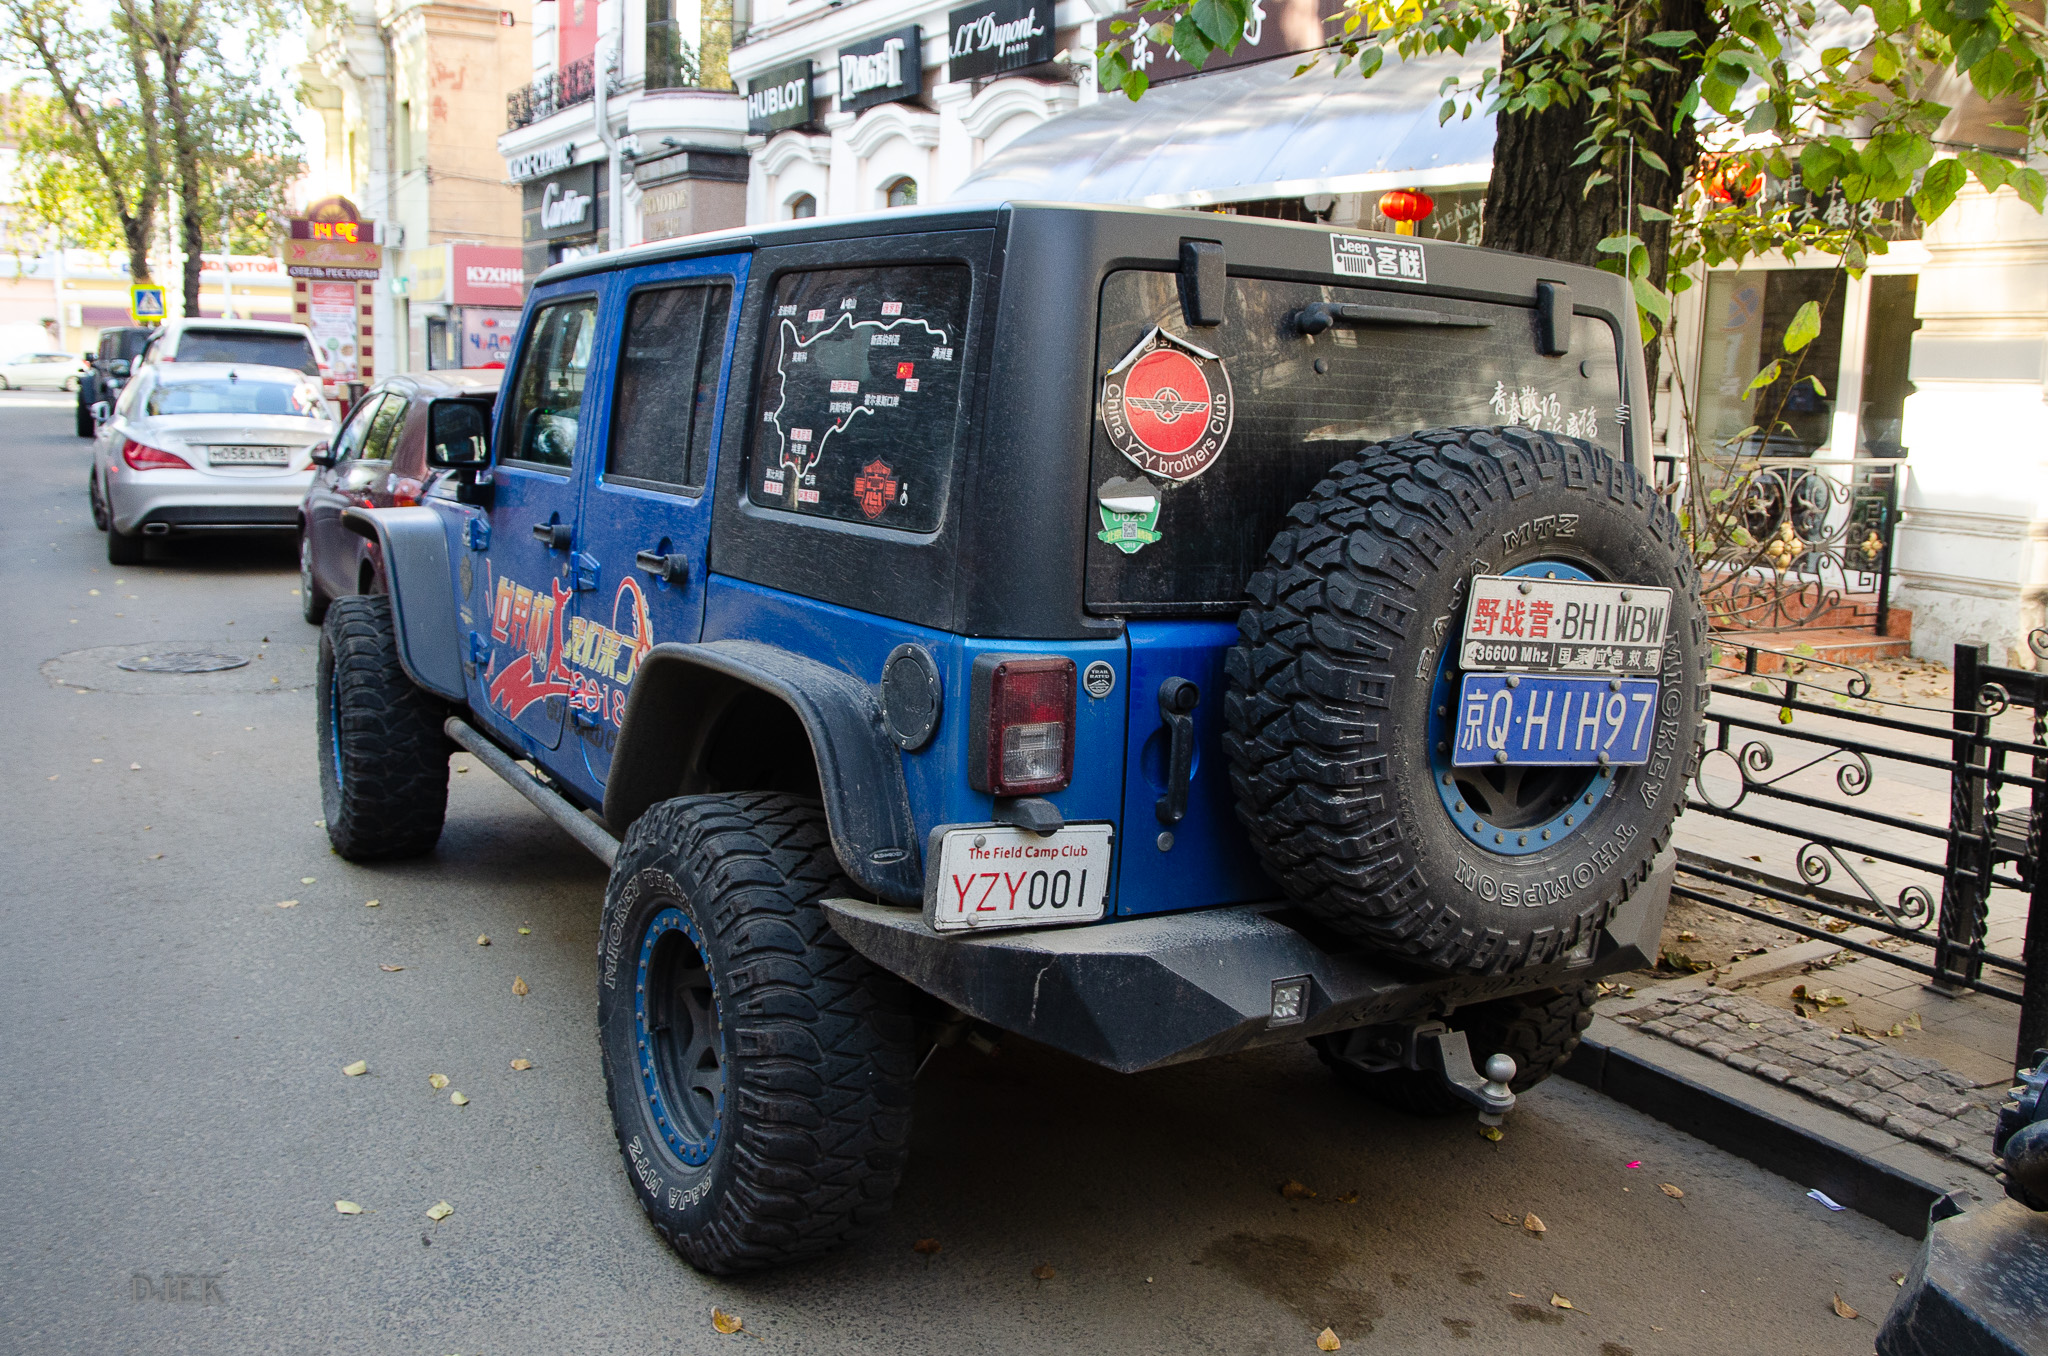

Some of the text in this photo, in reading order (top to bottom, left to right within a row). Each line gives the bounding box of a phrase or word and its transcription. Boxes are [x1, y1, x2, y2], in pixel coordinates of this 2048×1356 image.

[978, 7, 1044, 57] Dupont
[1006, 42, 1029, 54] PARIS
[840, 38, 905, 101] PIAGET
[748, 79, 806, 120] HUBLOT
[541, 182, 592, 230] Cartier
[313, 222, 333, 240] 14
[1339, 239, 1371, 256] Jeep
[289, 267, 379, 279] ОТЕЛЬ РЕСТОРАН
[466, 266, 524, 282] КУХНИ
[1375, 246, 1421, 277] 客栈
[905, 380, 918, 391] 中国
[1107, 383, 1226, 473] China YZY brothers Club
[1503, 513, 1579, 555] MTZ
[564, 615, 643, 686] 我们来了
[1469, 643, 1548, 663] 436600 Mhz
[1558, 647, 1661, 670] 国家应急救援
[1639, 631, 1683, 810] MICKEY
[969, 845, 1088, 861] The Field Camp Club
[1454, 824, 1639, 908] THOMPSON
[953, 869, 1088, 913] YZY001
[604, 874, 640, 990] MICKEY
[628, 1135, 712, 1210] BAJA MTZ
